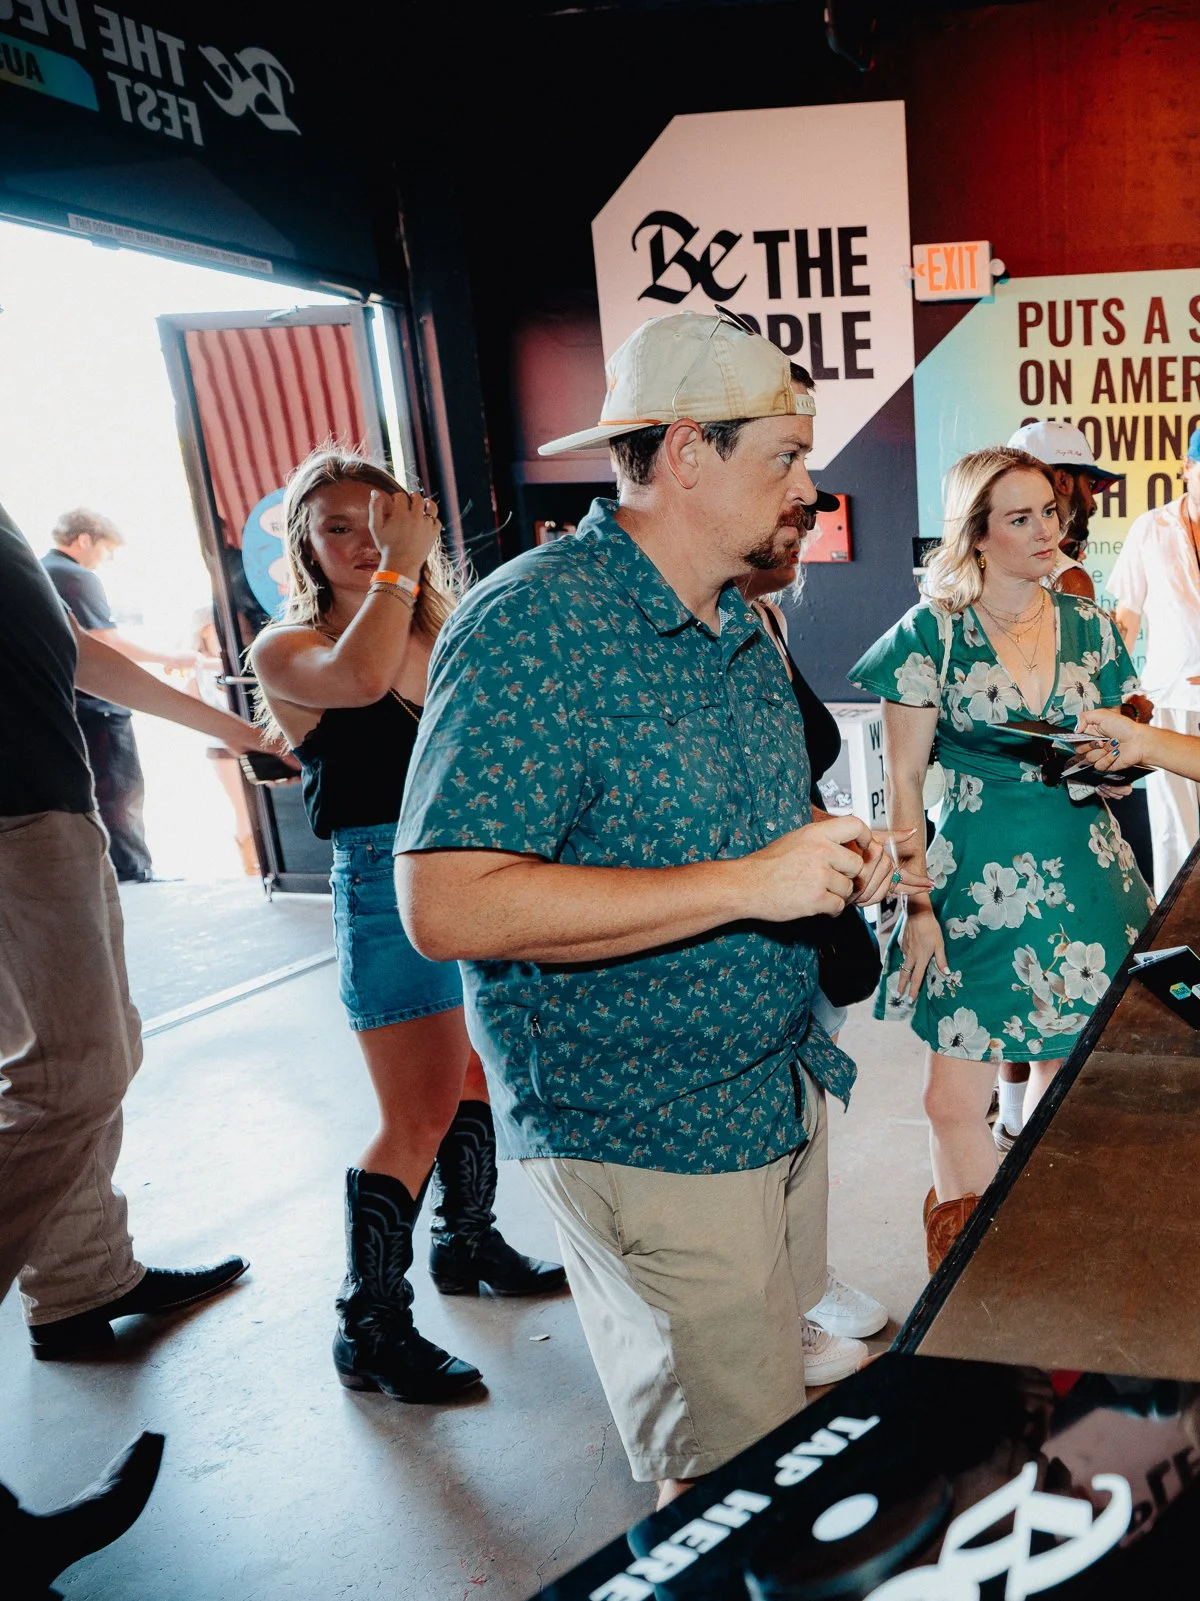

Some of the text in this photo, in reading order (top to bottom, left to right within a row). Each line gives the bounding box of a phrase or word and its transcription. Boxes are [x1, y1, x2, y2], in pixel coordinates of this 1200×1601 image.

[753, 225, 871, 300] THE
[927, 245, 979, 292] EXIT
[1018, 297, 1126, 348] PUTS
[1143, 296, 1170, 344] A
[1018, 358, 1072, 406] ON
[589, 1414, 881, 1601] TAP HERE
